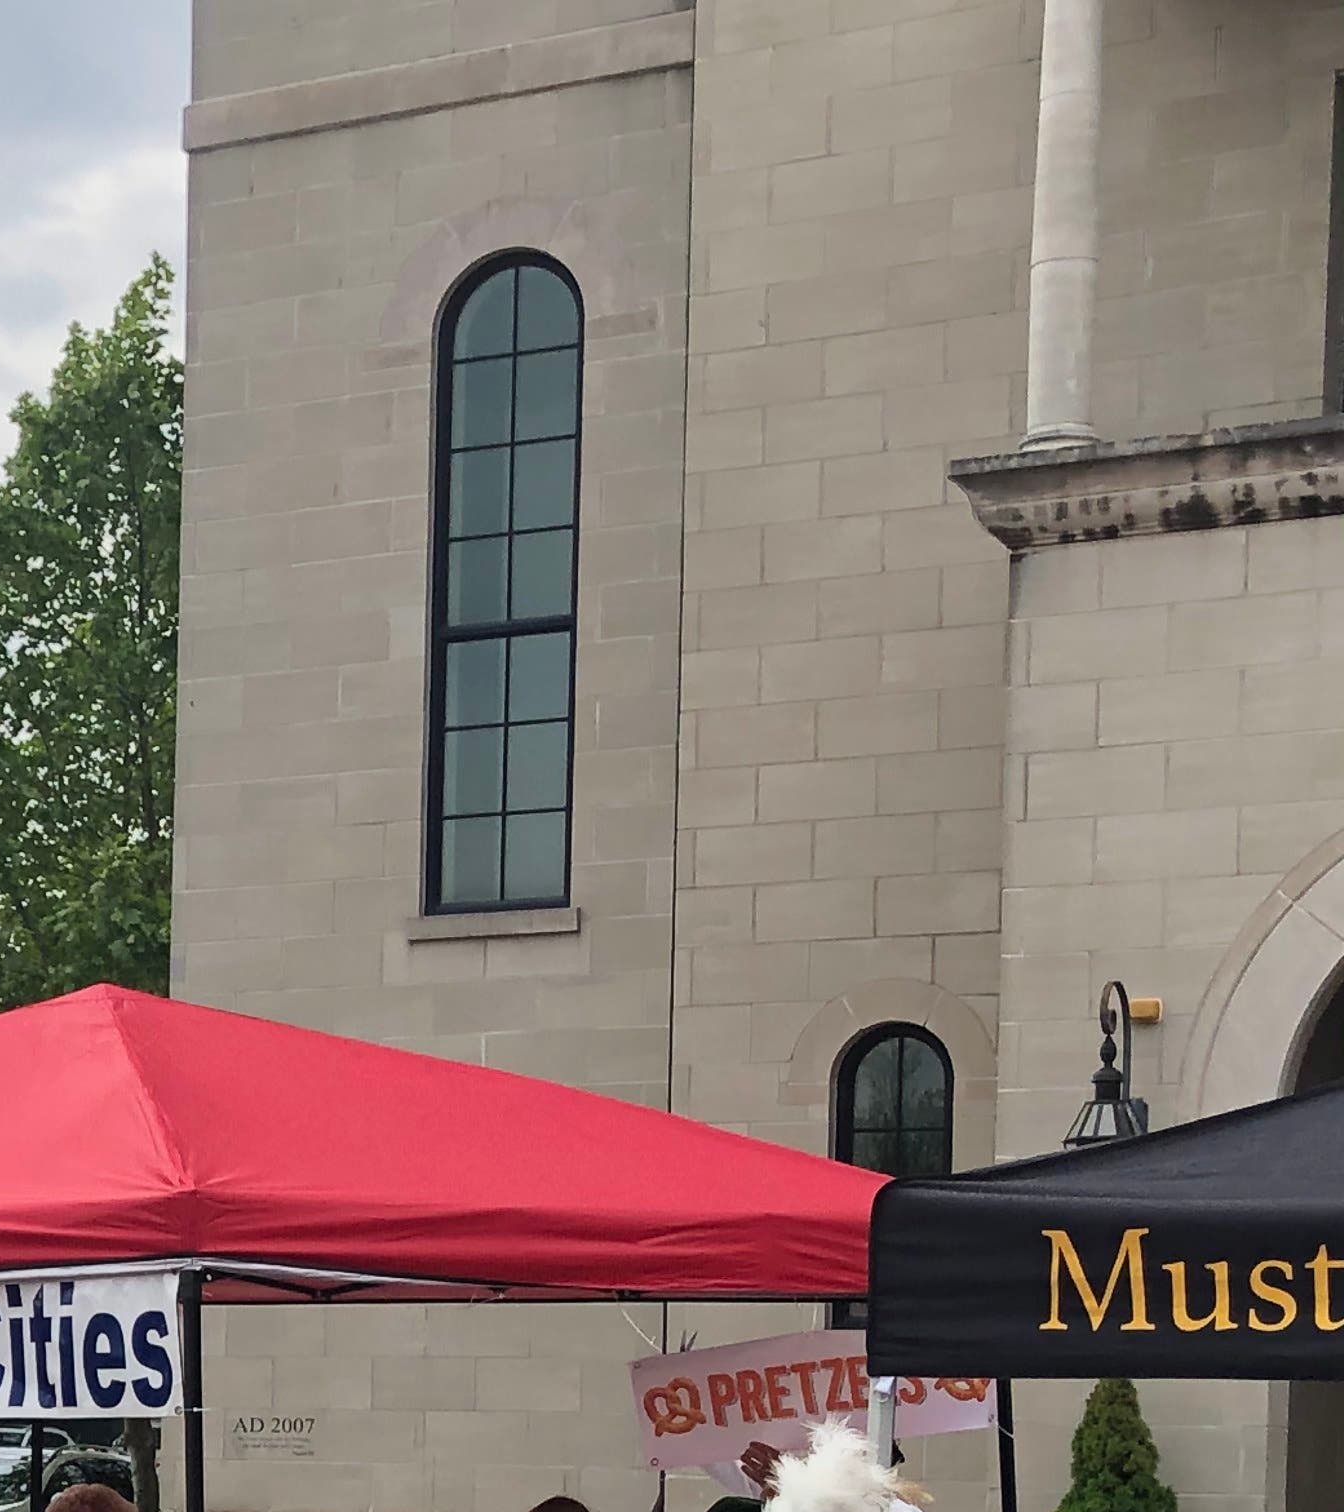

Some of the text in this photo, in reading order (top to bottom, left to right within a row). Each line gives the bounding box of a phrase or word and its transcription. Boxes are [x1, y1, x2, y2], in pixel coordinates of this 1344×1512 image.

[1039, 1228, 1344, 1332] Must
[232, 1417, 316, 1434] AD 2007
[707, 1355, 928, 1428] PRETZES
